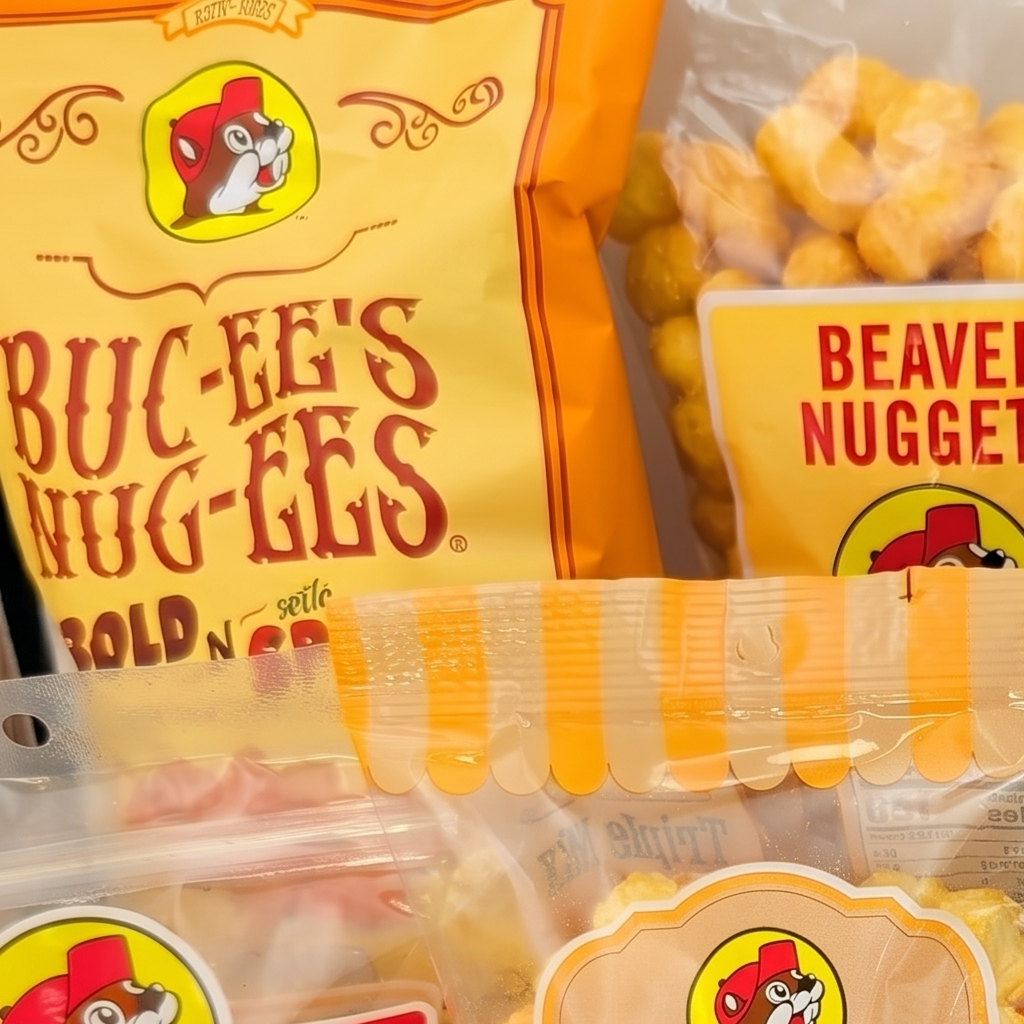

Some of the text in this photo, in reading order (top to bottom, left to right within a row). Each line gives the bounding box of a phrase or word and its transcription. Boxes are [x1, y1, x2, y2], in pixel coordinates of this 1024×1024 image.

[0, 298, 439, 479] BUC-EE'S
[18, 406, 448, 579] NUG-EES
[60, 595, 199, 671] BOLD
